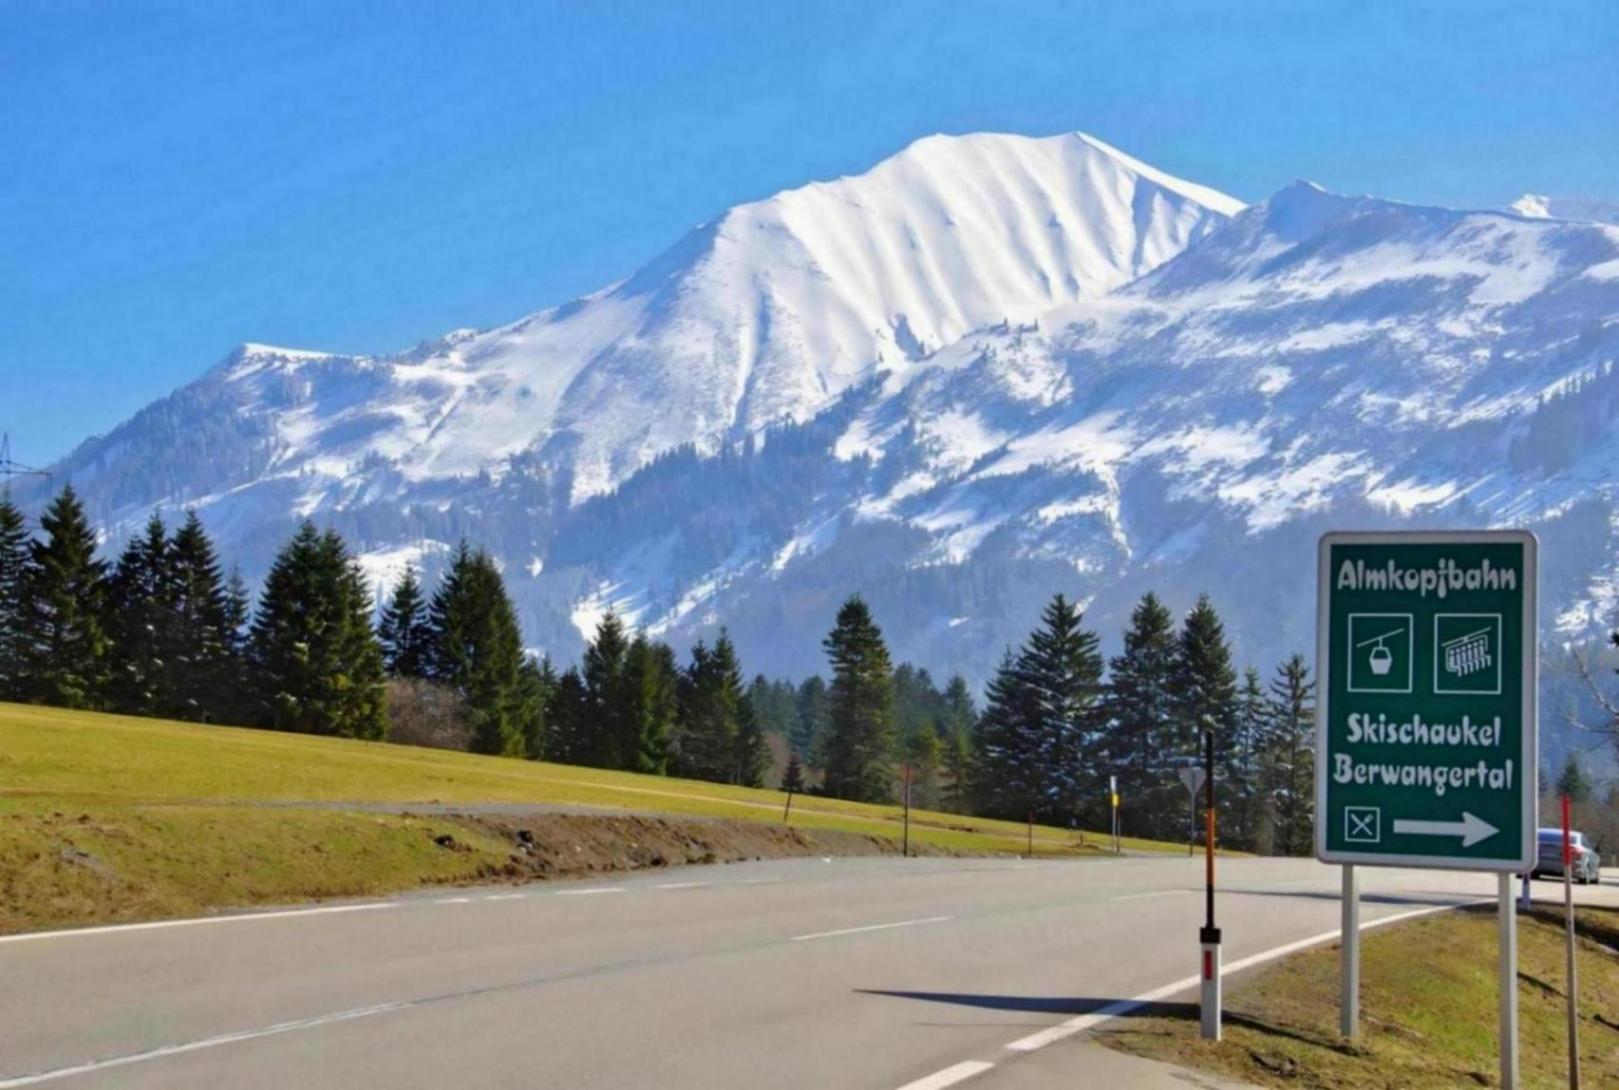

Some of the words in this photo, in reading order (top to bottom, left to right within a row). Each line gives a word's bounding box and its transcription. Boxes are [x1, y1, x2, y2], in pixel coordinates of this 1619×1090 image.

[1337, 557, 1516, 598] Almkopfbahn
[1347, 713, 1501, 747] Skischaukel
[1333, 753, 1513, 796] Berwangertal
